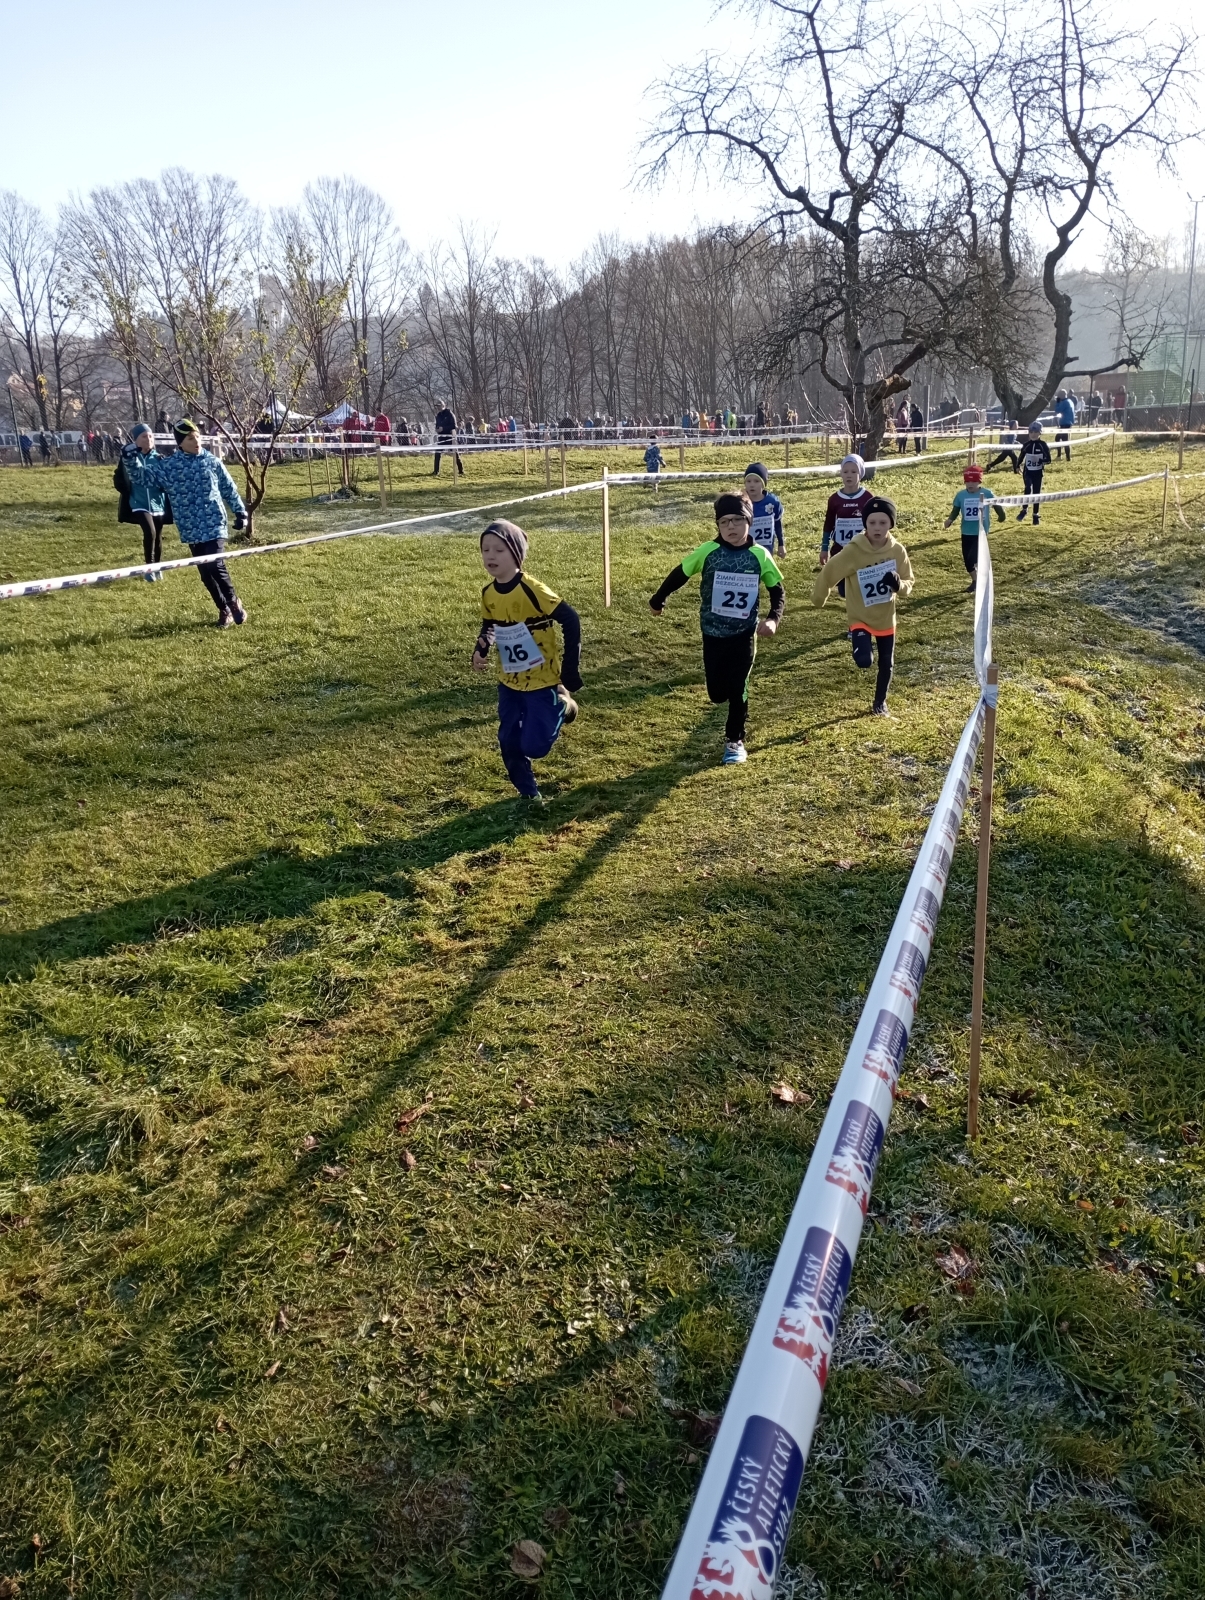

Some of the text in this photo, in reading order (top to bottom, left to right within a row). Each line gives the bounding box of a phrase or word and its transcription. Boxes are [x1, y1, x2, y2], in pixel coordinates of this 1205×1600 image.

[754, 527, 772, 540] 25
[721, 590, 750, 610] 23
[864, 580, 892, 599] 26
[504, 643, 529, 663] 26
[842, 1118, 863, 1147] ČESKÝ
[796, 1252, 823, 1292] ČESKÝ
[819, 1240, 845, 1308] ATLETICKÝ
[726, 1456, 763, 1514] ČESKÝ
[755, 1430, 794, 1535] ATLETICKÝ
[773, 1496, 792, 1555] SVAZ
